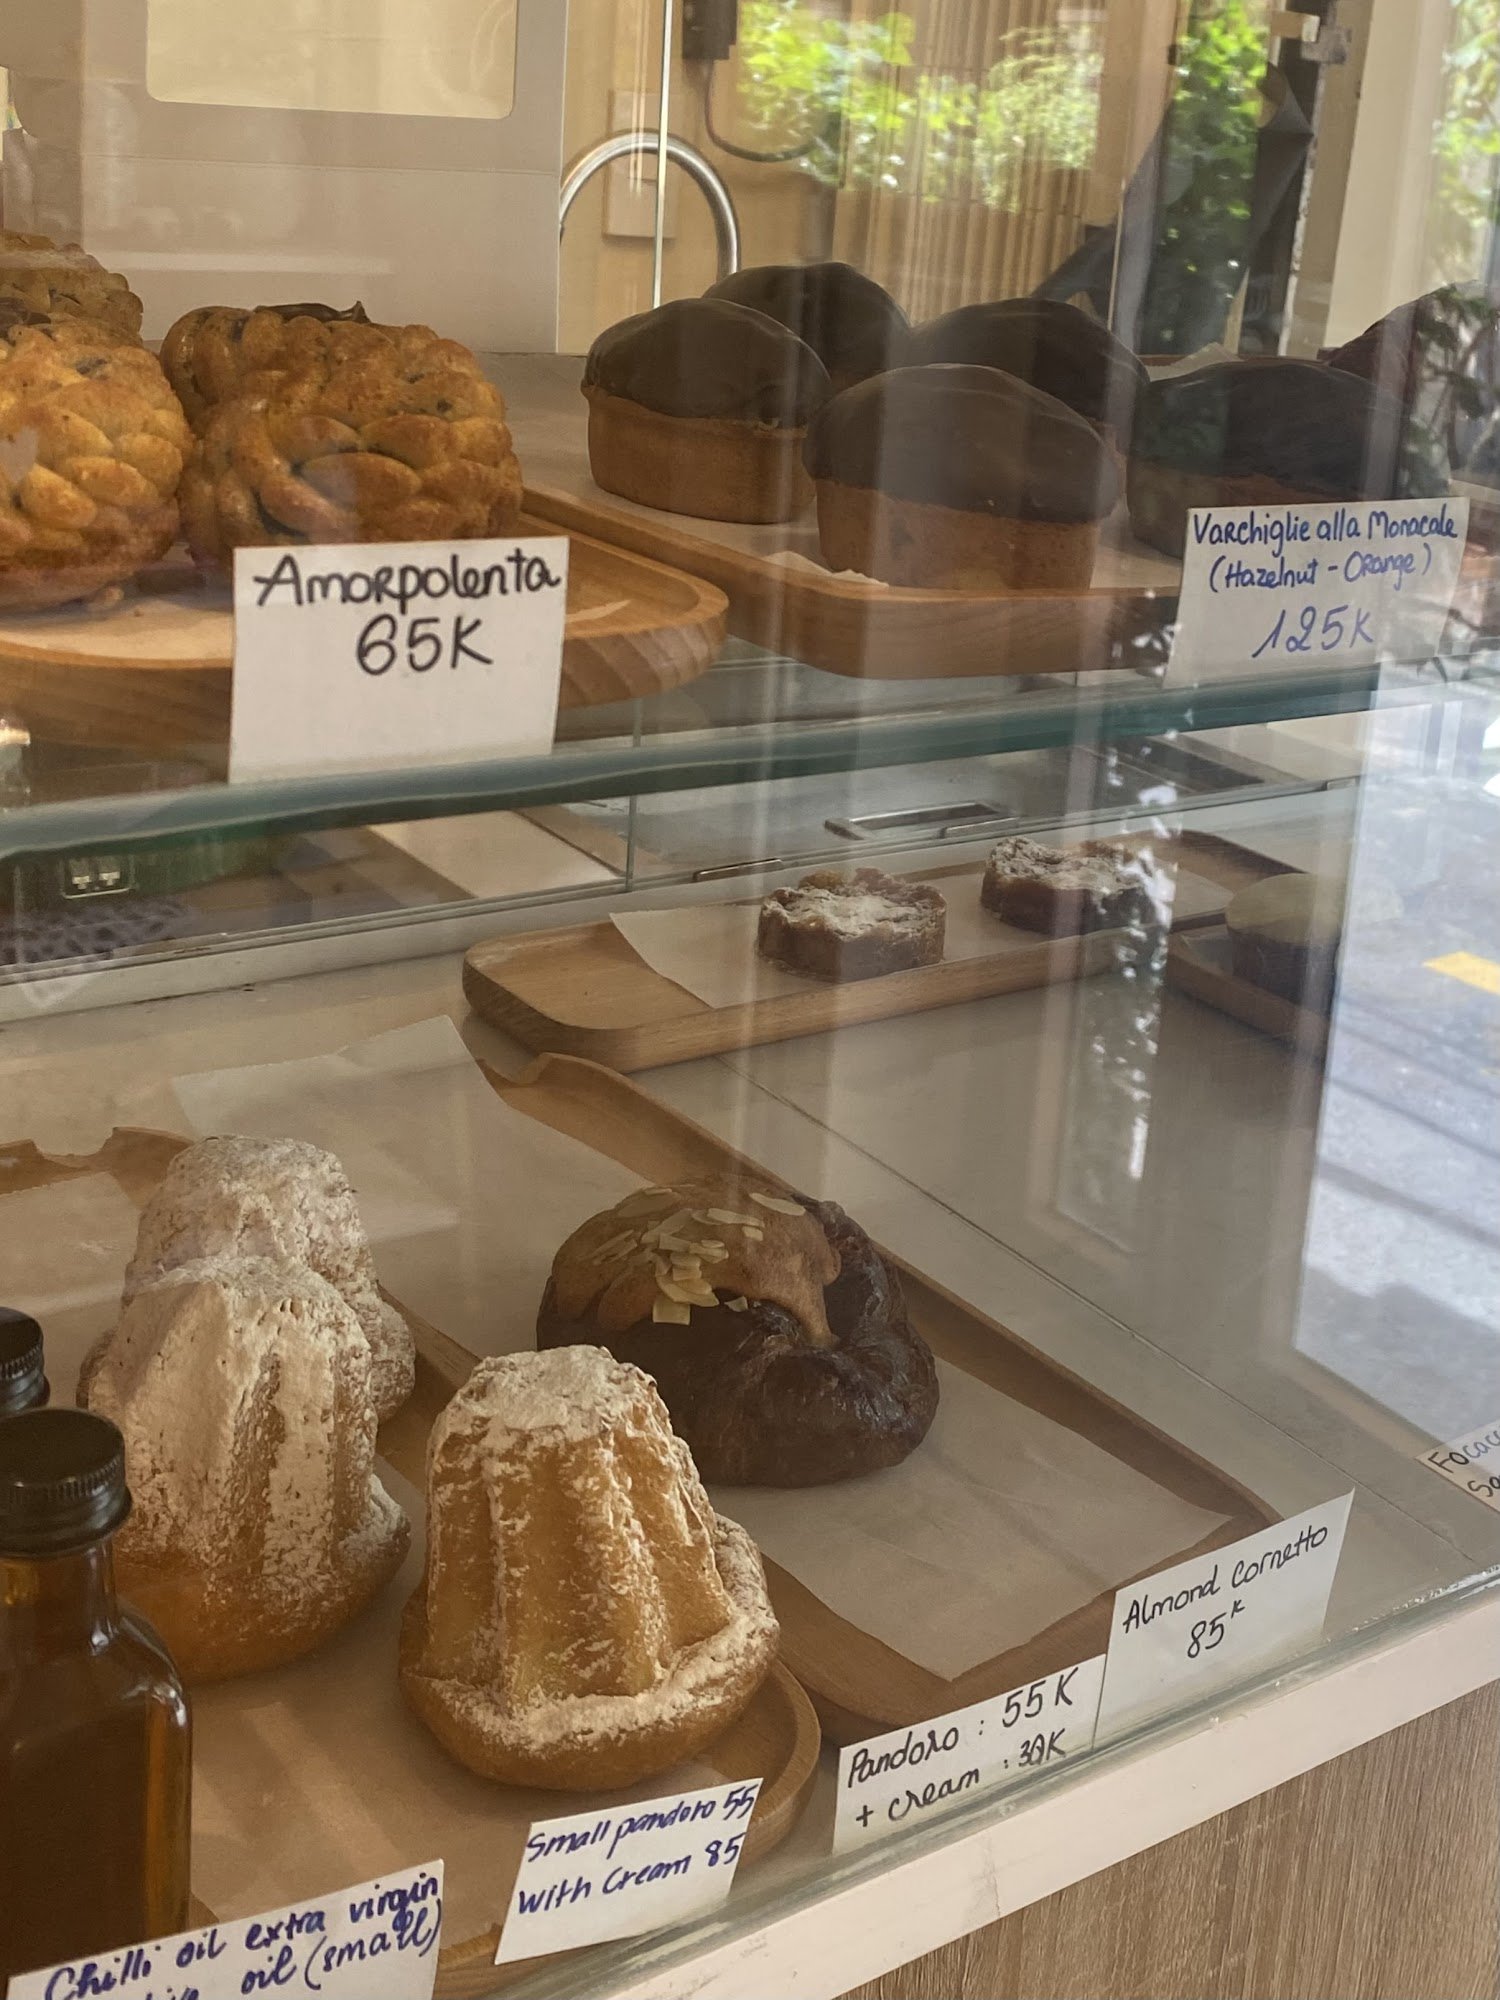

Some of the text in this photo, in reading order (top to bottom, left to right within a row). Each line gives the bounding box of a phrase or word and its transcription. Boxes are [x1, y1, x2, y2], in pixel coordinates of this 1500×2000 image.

[1316, 507, 1361, 542] alla
[253, 547, 561, 614] Amorpolenta
[1209, 554, 1319, 593] (Hazelnut
[356, 614, 494, 676] 65K
[1251, 605, 1374, 658] 125K
[1122, 1525, 1328, 1634] Almond Cornetto
[847, 1727, 959, 1788] Pandoro
[526, 1820, 611, 1863] Small
[722, 1784, 759, 1821] 55
[704, 1832, 746, 1868] 85
[44, 1871, 438, 2000] Chilli oil extra virgin
[240, 1945, 297, 1995] oil
